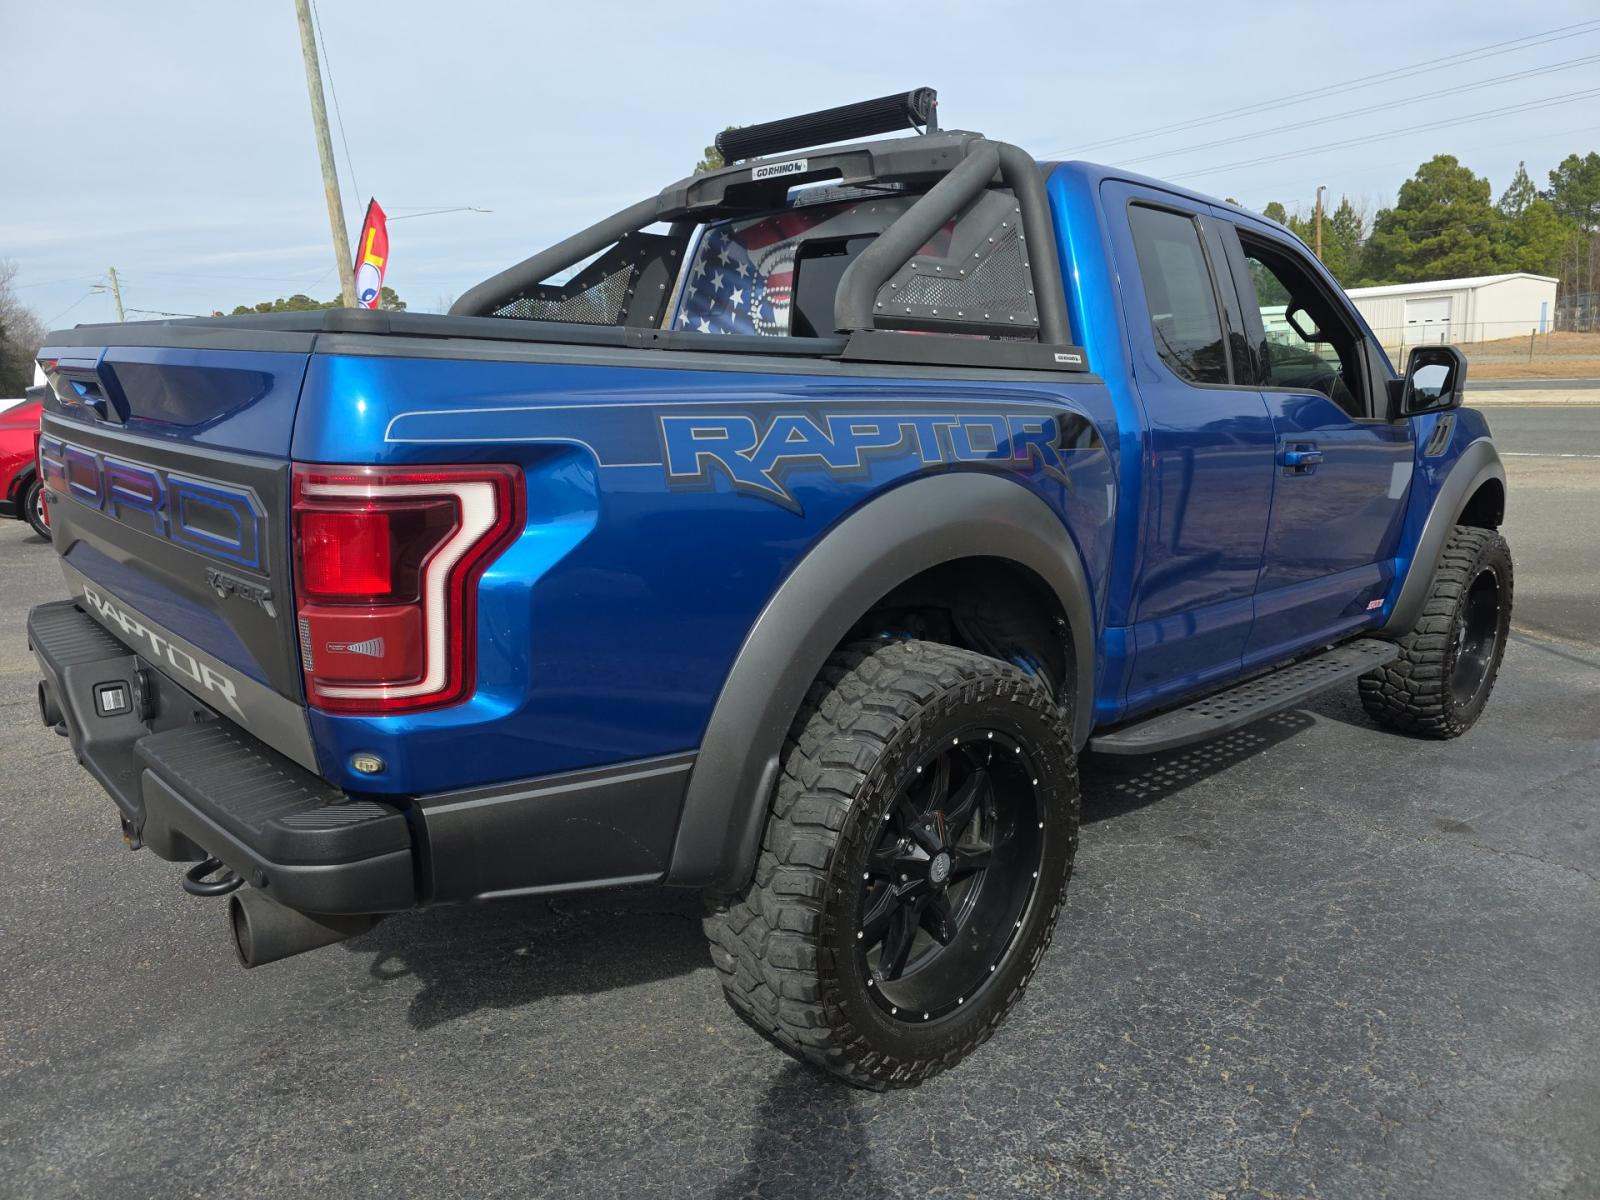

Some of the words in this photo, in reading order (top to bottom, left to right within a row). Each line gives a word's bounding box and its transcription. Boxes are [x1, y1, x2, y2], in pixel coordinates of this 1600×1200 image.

[40, 434, 264, 569] FORD
[658, 413, 1073, 514] RAPTOR
[82, 583, 248, 722] RAPTOR
